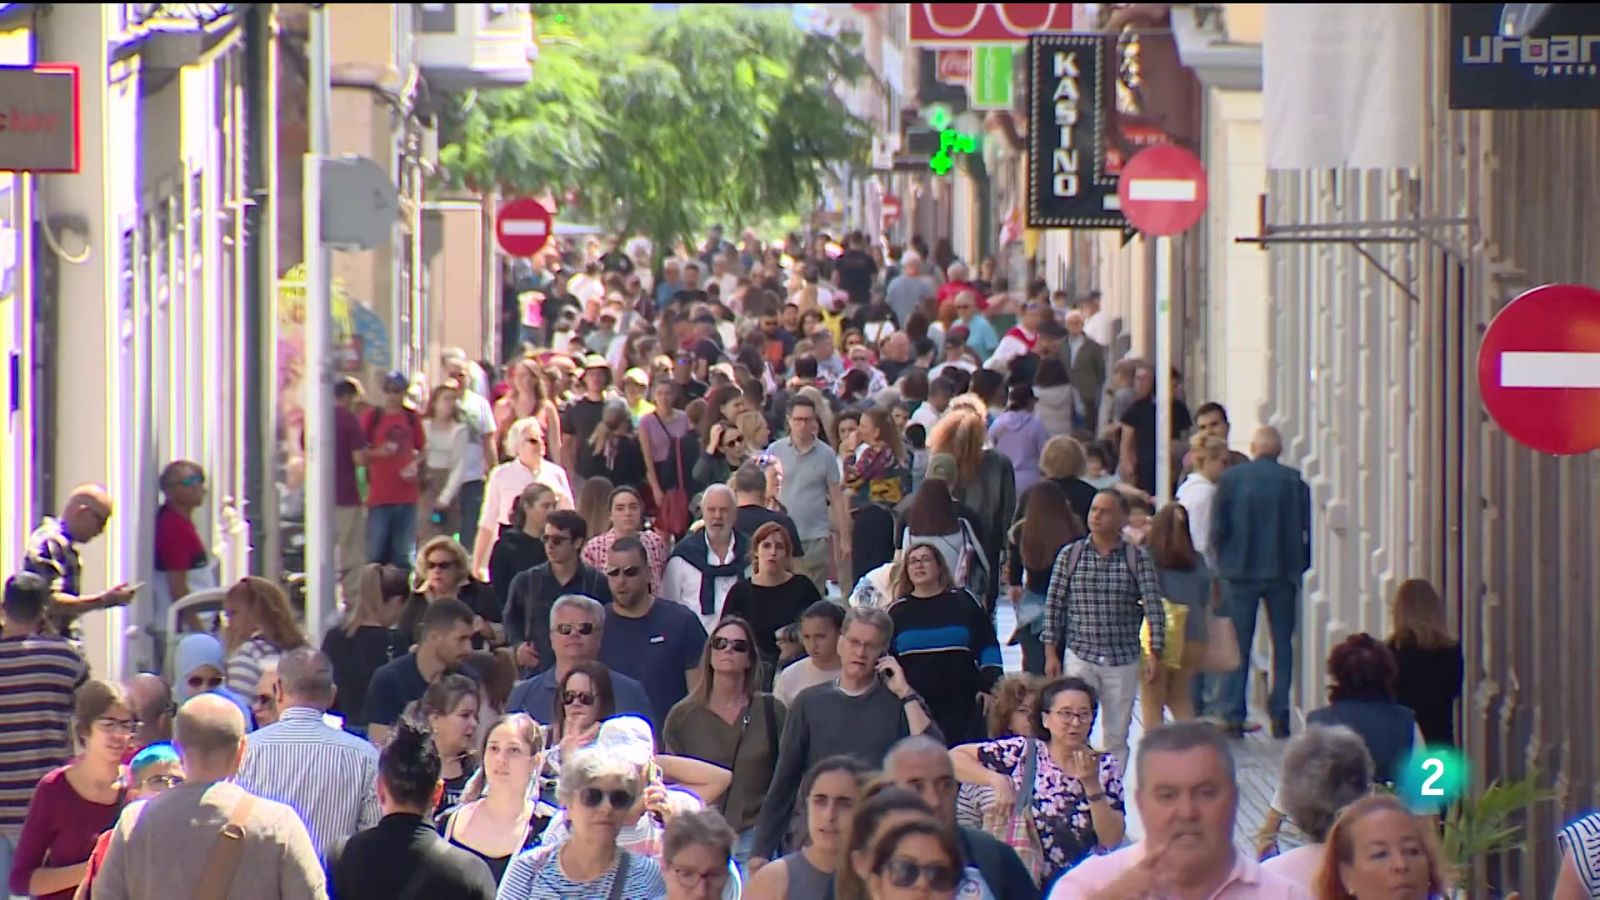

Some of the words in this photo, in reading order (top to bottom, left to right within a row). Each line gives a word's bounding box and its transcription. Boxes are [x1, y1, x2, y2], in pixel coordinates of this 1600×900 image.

[1462, 35, 1600, 63] urban
[1534, 65, 1548, 77] by
[1053, 51, 1080, 197] KASINO
